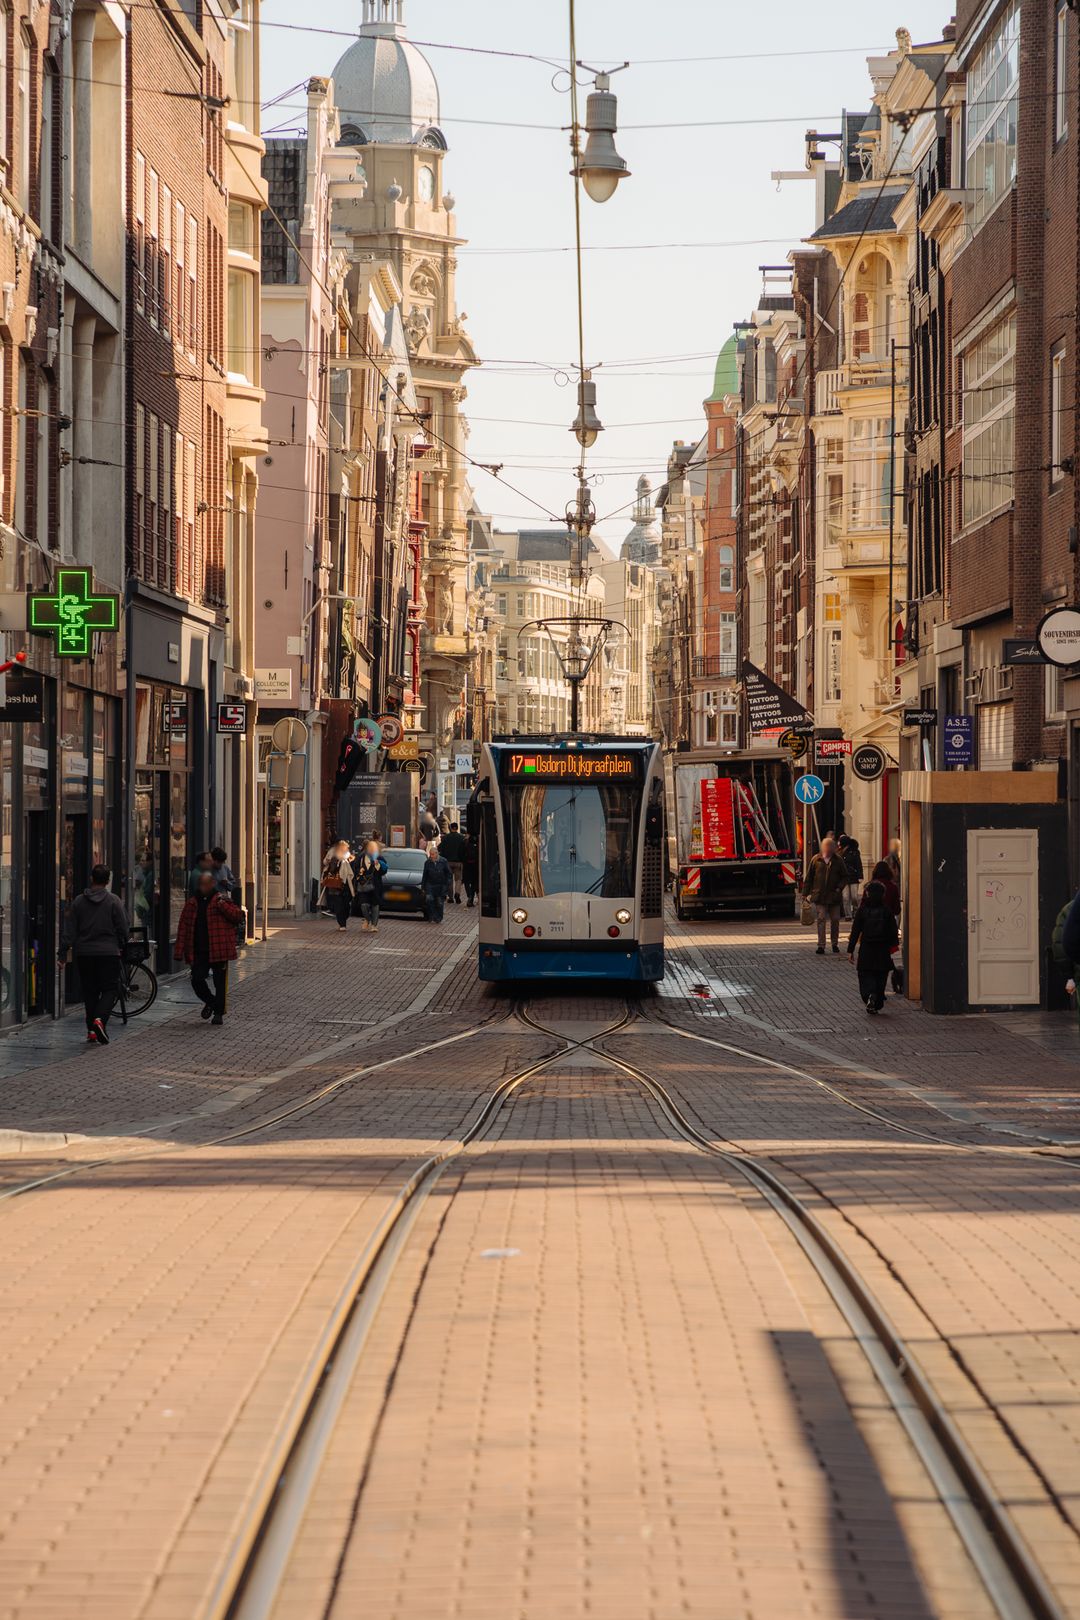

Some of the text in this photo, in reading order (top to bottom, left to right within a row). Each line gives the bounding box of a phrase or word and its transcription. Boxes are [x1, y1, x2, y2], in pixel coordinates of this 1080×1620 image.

[1011, 645, 1040, 658] Suba
[268, 672, 277, 681] M
[6, 694, 38, 703] ass hut
[748, 695, 779, 704] TATTOOS
[750, 702, 780, 712] PIERCINGS
[751, 710, 782, 719] TATTOOS
[752, 714, 804, 728] PAX TATTOOS
[391, 745, 416, 756] e&e
[823, 743, 850, 753] CAMPER
[511, 754, 632, 777] 17 Osdorp Dijkgraafplein
